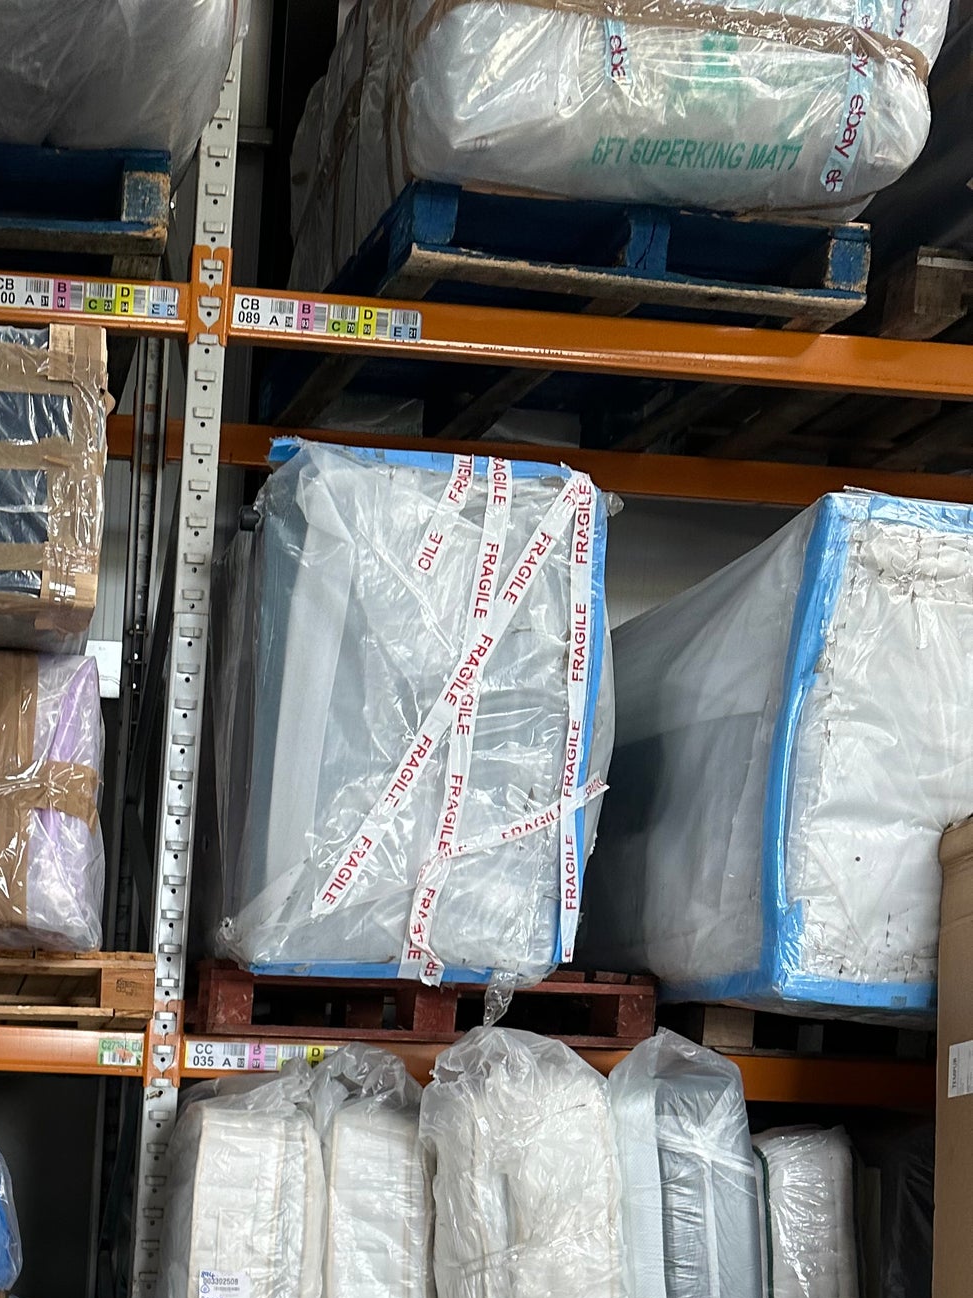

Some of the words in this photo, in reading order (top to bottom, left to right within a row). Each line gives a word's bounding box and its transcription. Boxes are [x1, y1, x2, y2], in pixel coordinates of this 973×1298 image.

[835, 94, 867, 159] ebay
[591, 136, 625, 165] 6FT
[630, 137, 746, 169] SUPERKING
[745, 143, 804, 171] MATT
[57, 282, 67, 293] B
[120, 286, 130, 298] D
[24, 294, 35, 306] A
[88, 298, 98, 310] C
[240, 297, 260, 311] CB
[152, 303, 161, 315] E
[302, 303, 311, 315] B
[364, 309, 374, 320] D
[238, 310, 261, 325] 089
[269, 315, 279, 327] A
[331, 321, 341, 332] C
[393, 326, 403, 337] E
[575, 484, 592, 565] FRAGILE
[418, 531, 444, 572] GILE
[502, 531, 553, 606] FRAGILE
[473, 541, 500, 619] FRAGILE
[572, 602, 587, 683] FRAGILE
[444, 633, 494, 707] FRAGILE
[564, 719, 581, 798] FRAGILE
[384, 734, 433, 808] FRAGILE
[438, 774, 464, 856] FRAGILE
[322, 834, 372, 905] FRAGILE
[565, 834, 577, 910] FRAGILE
[195, 1043, 213, 1055] CC
[252, 1045, 261, 1055] B
[311, 1047, 321, 1057] D
[192, 1055, 214, 1067] 035
[221, 1057, 232, 1067] A
